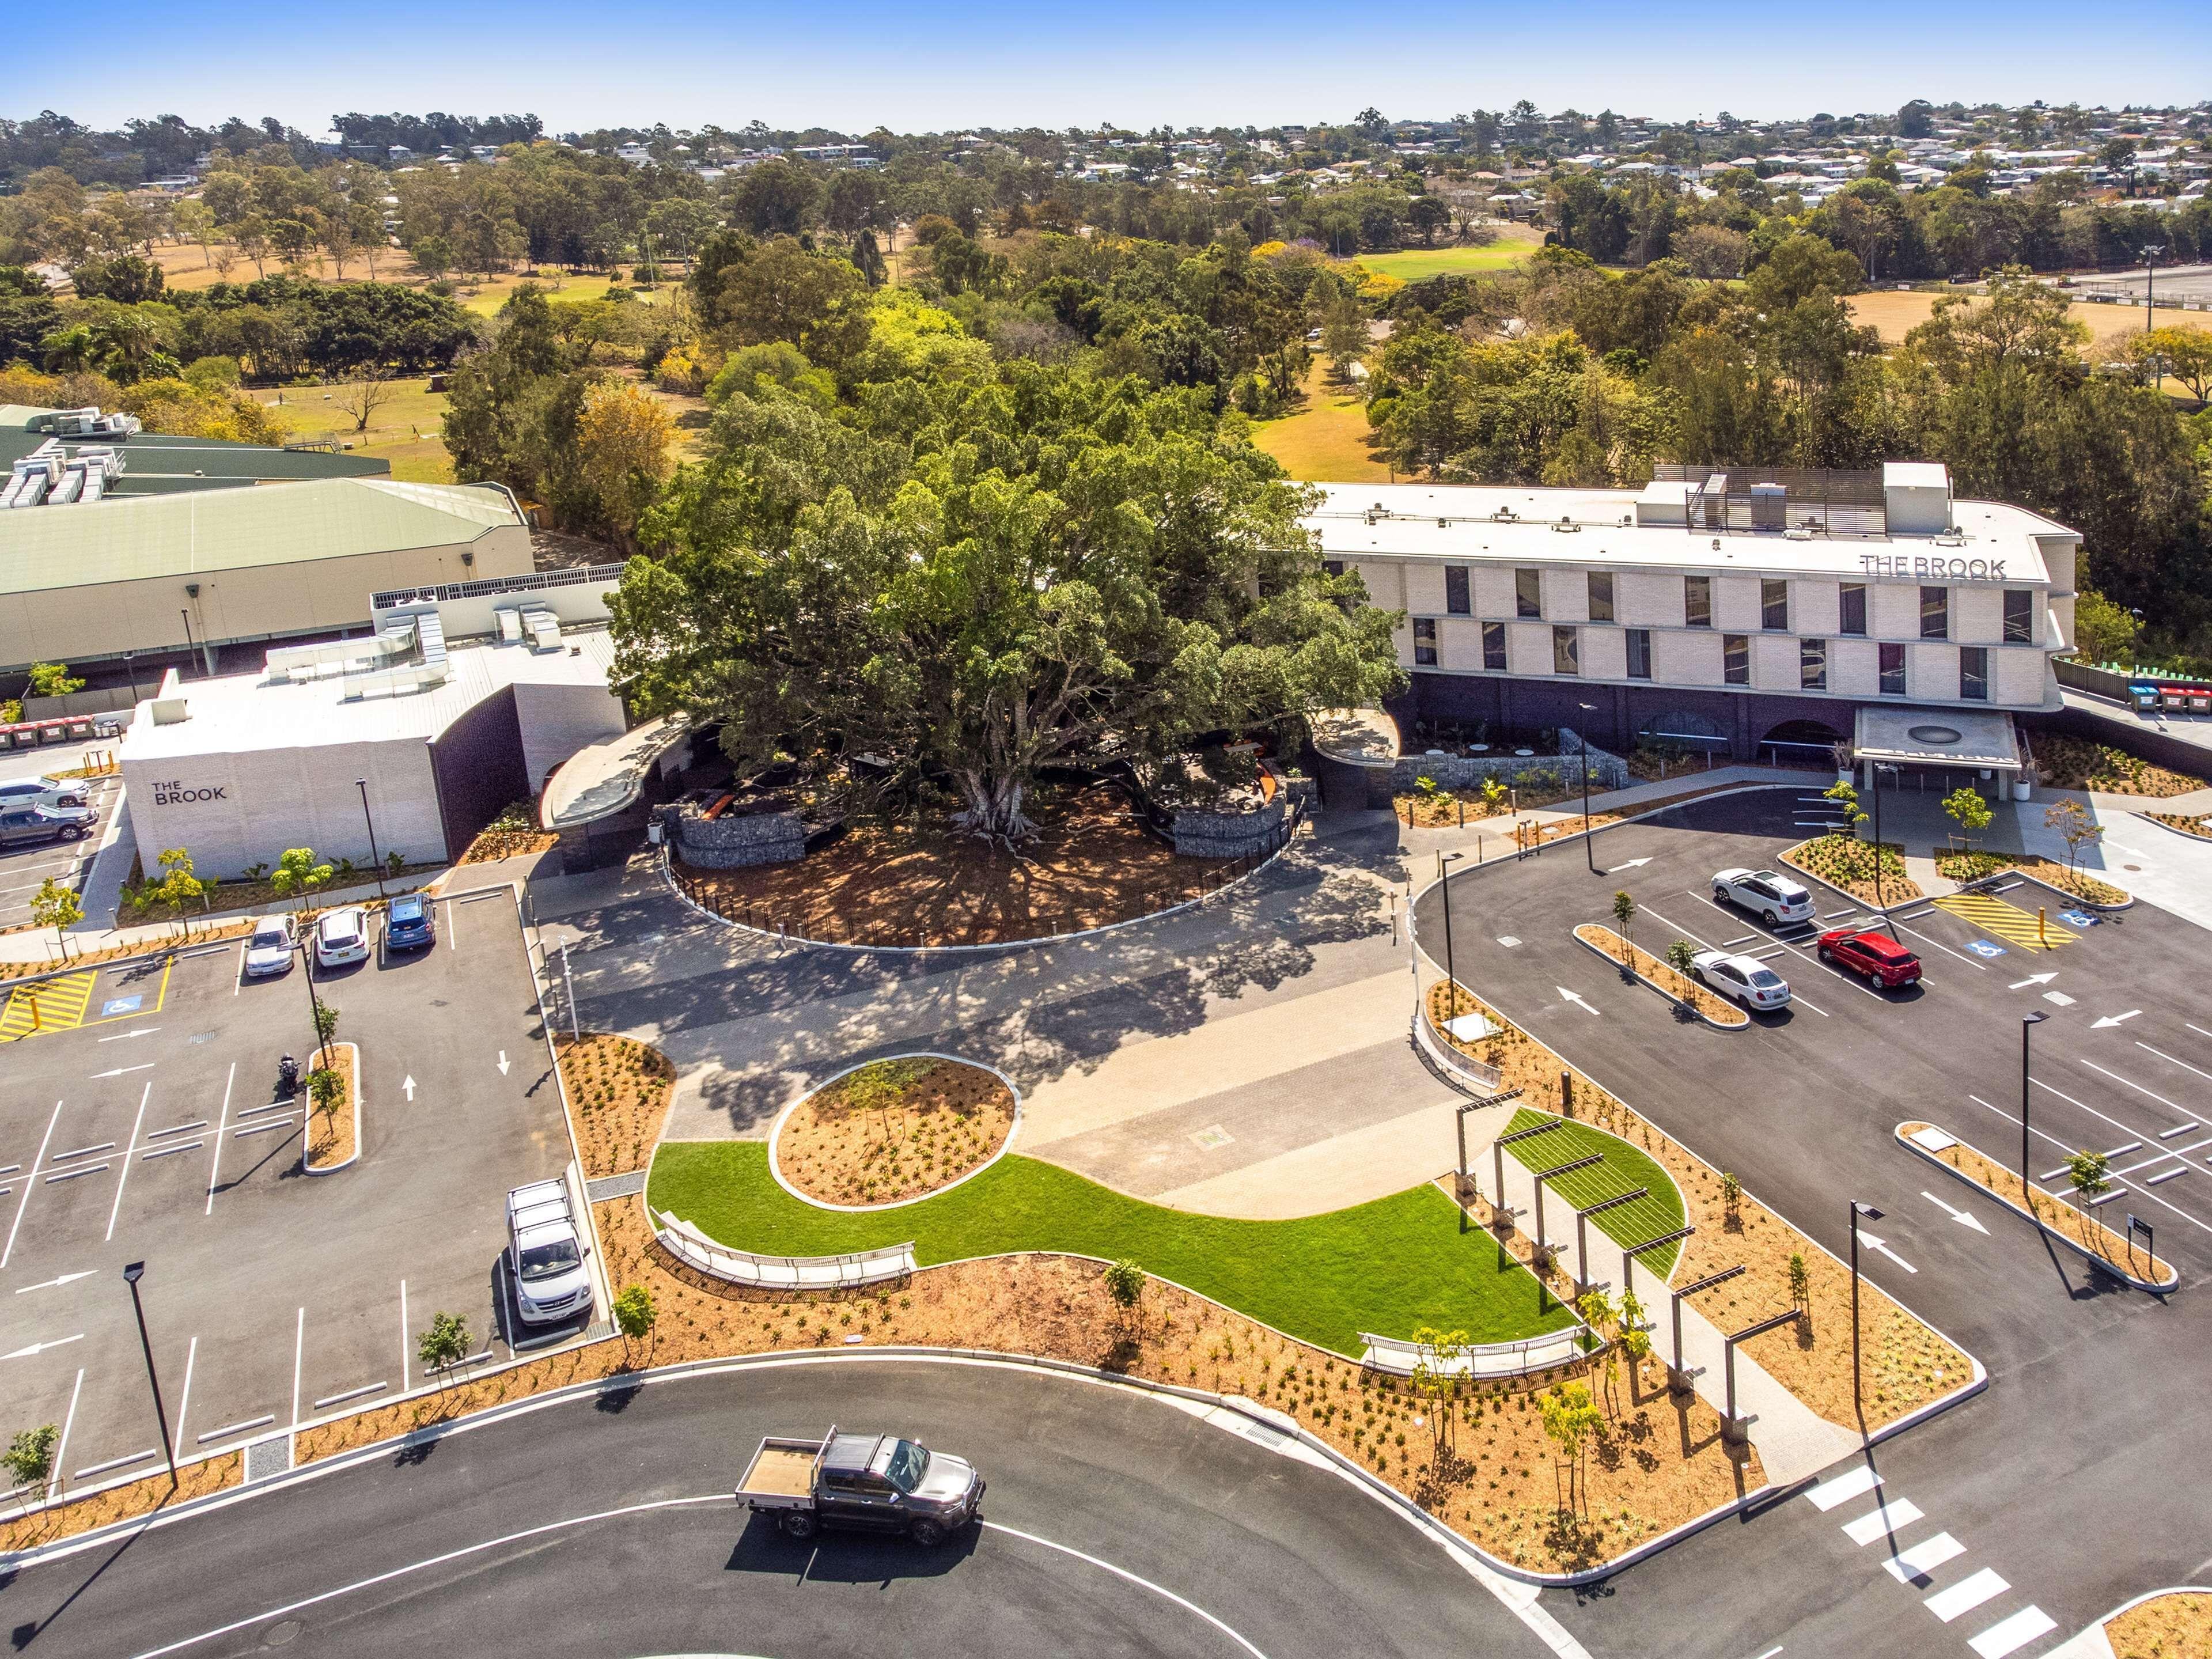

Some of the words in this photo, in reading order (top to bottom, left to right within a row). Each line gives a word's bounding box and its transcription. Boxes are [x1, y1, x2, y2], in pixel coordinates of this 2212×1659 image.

[1860, 555, 1908, 575] THE
[1915, 556, 2006, 579] BROOK
[151, 781, 183, 791] THE
[155, 787, 228, 805] BROOK
